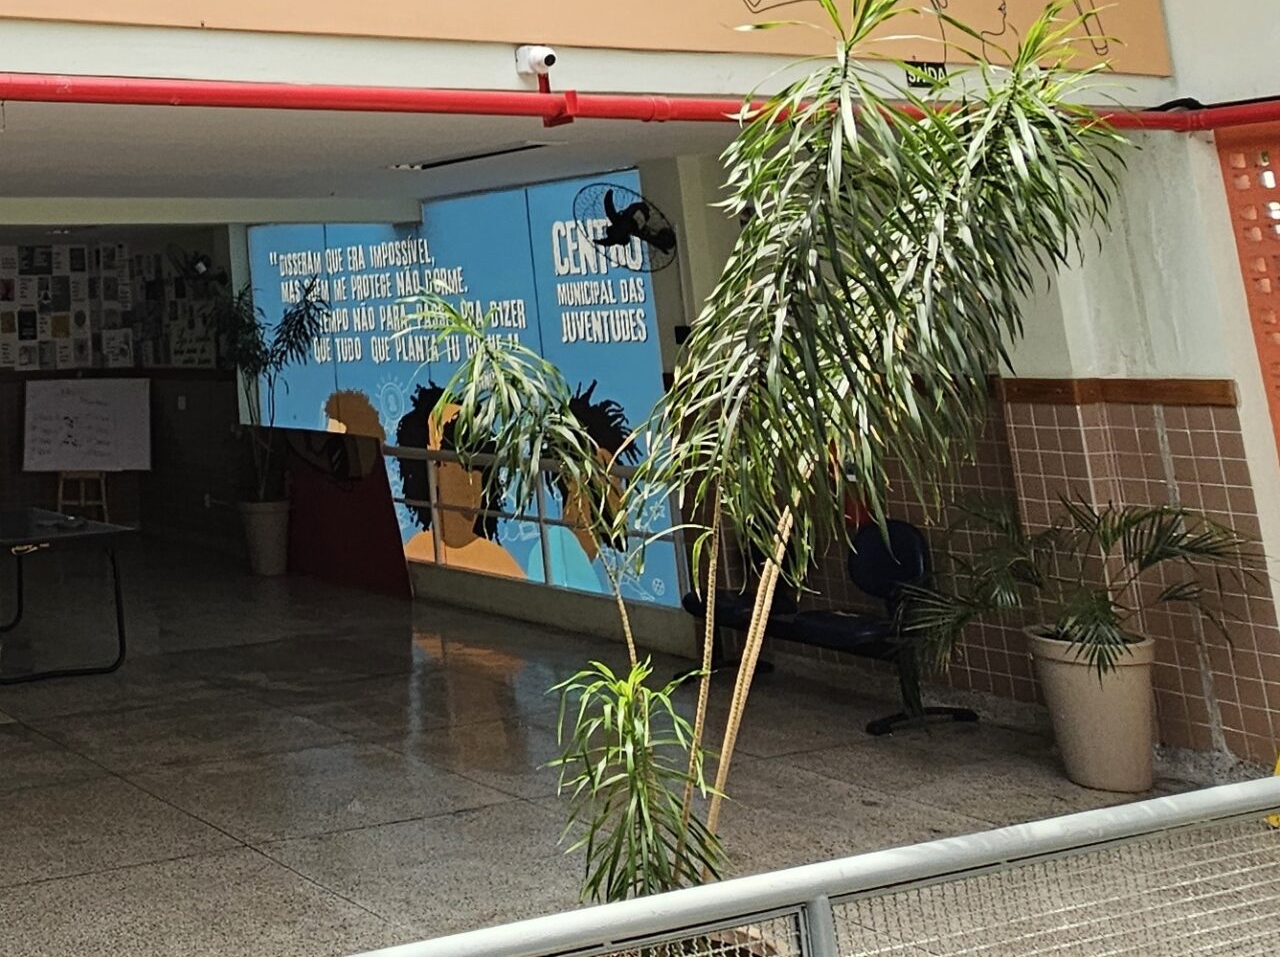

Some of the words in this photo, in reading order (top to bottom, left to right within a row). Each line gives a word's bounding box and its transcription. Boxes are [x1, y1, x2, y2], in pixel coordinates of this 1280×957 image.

[325, 248, 344, 275] QUE
[347, 245, 366, 272] ERA
[334, 276, 348, 301] ME
[351, 272, 392, 301] PROTEGE
[396, 267, 421, 297] NÃO
[556, 279, 617, 306] MUNICIPAL
[620, 277, 646, 304] DAS
[353, 302, 376, 332] NÃO
[490, 299, 527, 329] DIZER
[561, 308, 648, 343] JUVENTUDES
[314, 337, 333, 364] QUE
[335, 336, 363, 363] TUDO
[371, 335, 392, 364] QUE
[445, 334, 461, 363] TU
